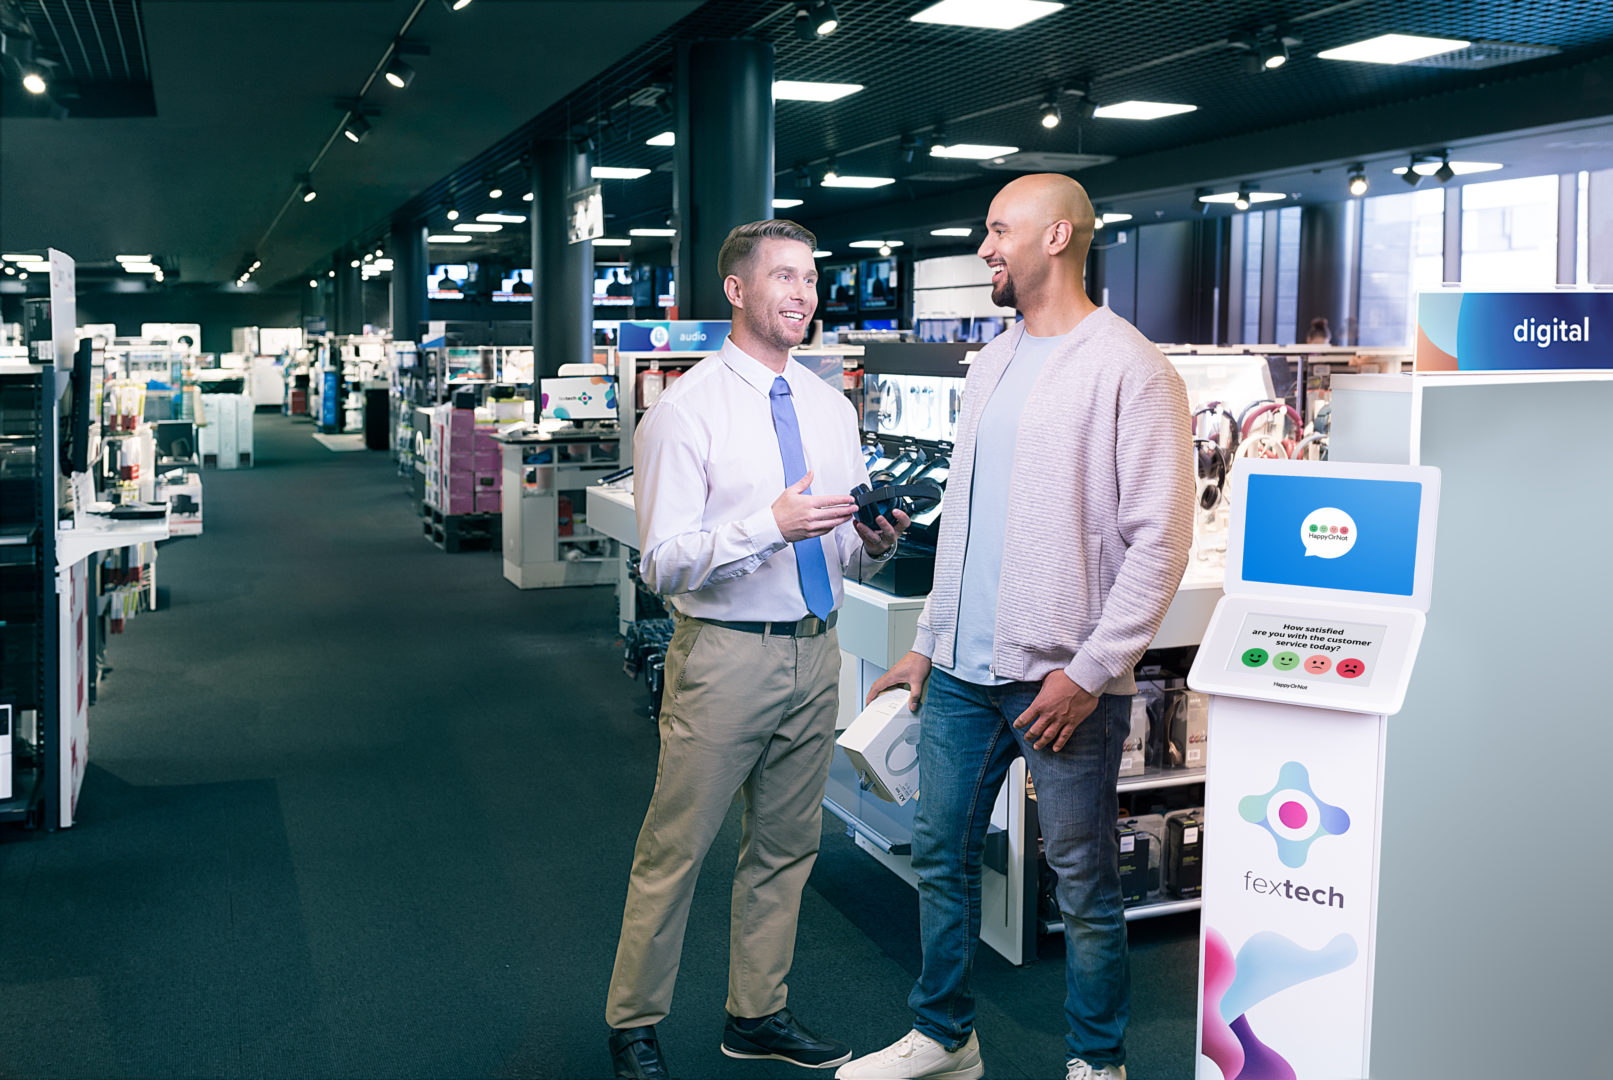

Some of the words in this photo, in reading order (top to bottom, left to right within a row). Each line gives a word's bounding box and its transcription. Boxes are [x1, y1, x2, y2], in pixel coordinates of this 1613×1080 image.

[679, 331, 707, 342] audio
[1513, 316, 1590, 348] digital
[1308, 533, 1348, 541] HappyOrNot
[1283, 623, 1304, 631] How
[1305, 626, 1345, 636] satisfied
[1268, 630, 1286, 638] you
[1287, 632, 1308, 640] with
[1327, 637, 1372, 647] customer
[1276, 639, 1308, 649] service
[1309, 642, 1342, 653] today?
[1273, 681, 1308, 690] HappyOrNot
[1244, 870, 1344, 909] fextech
